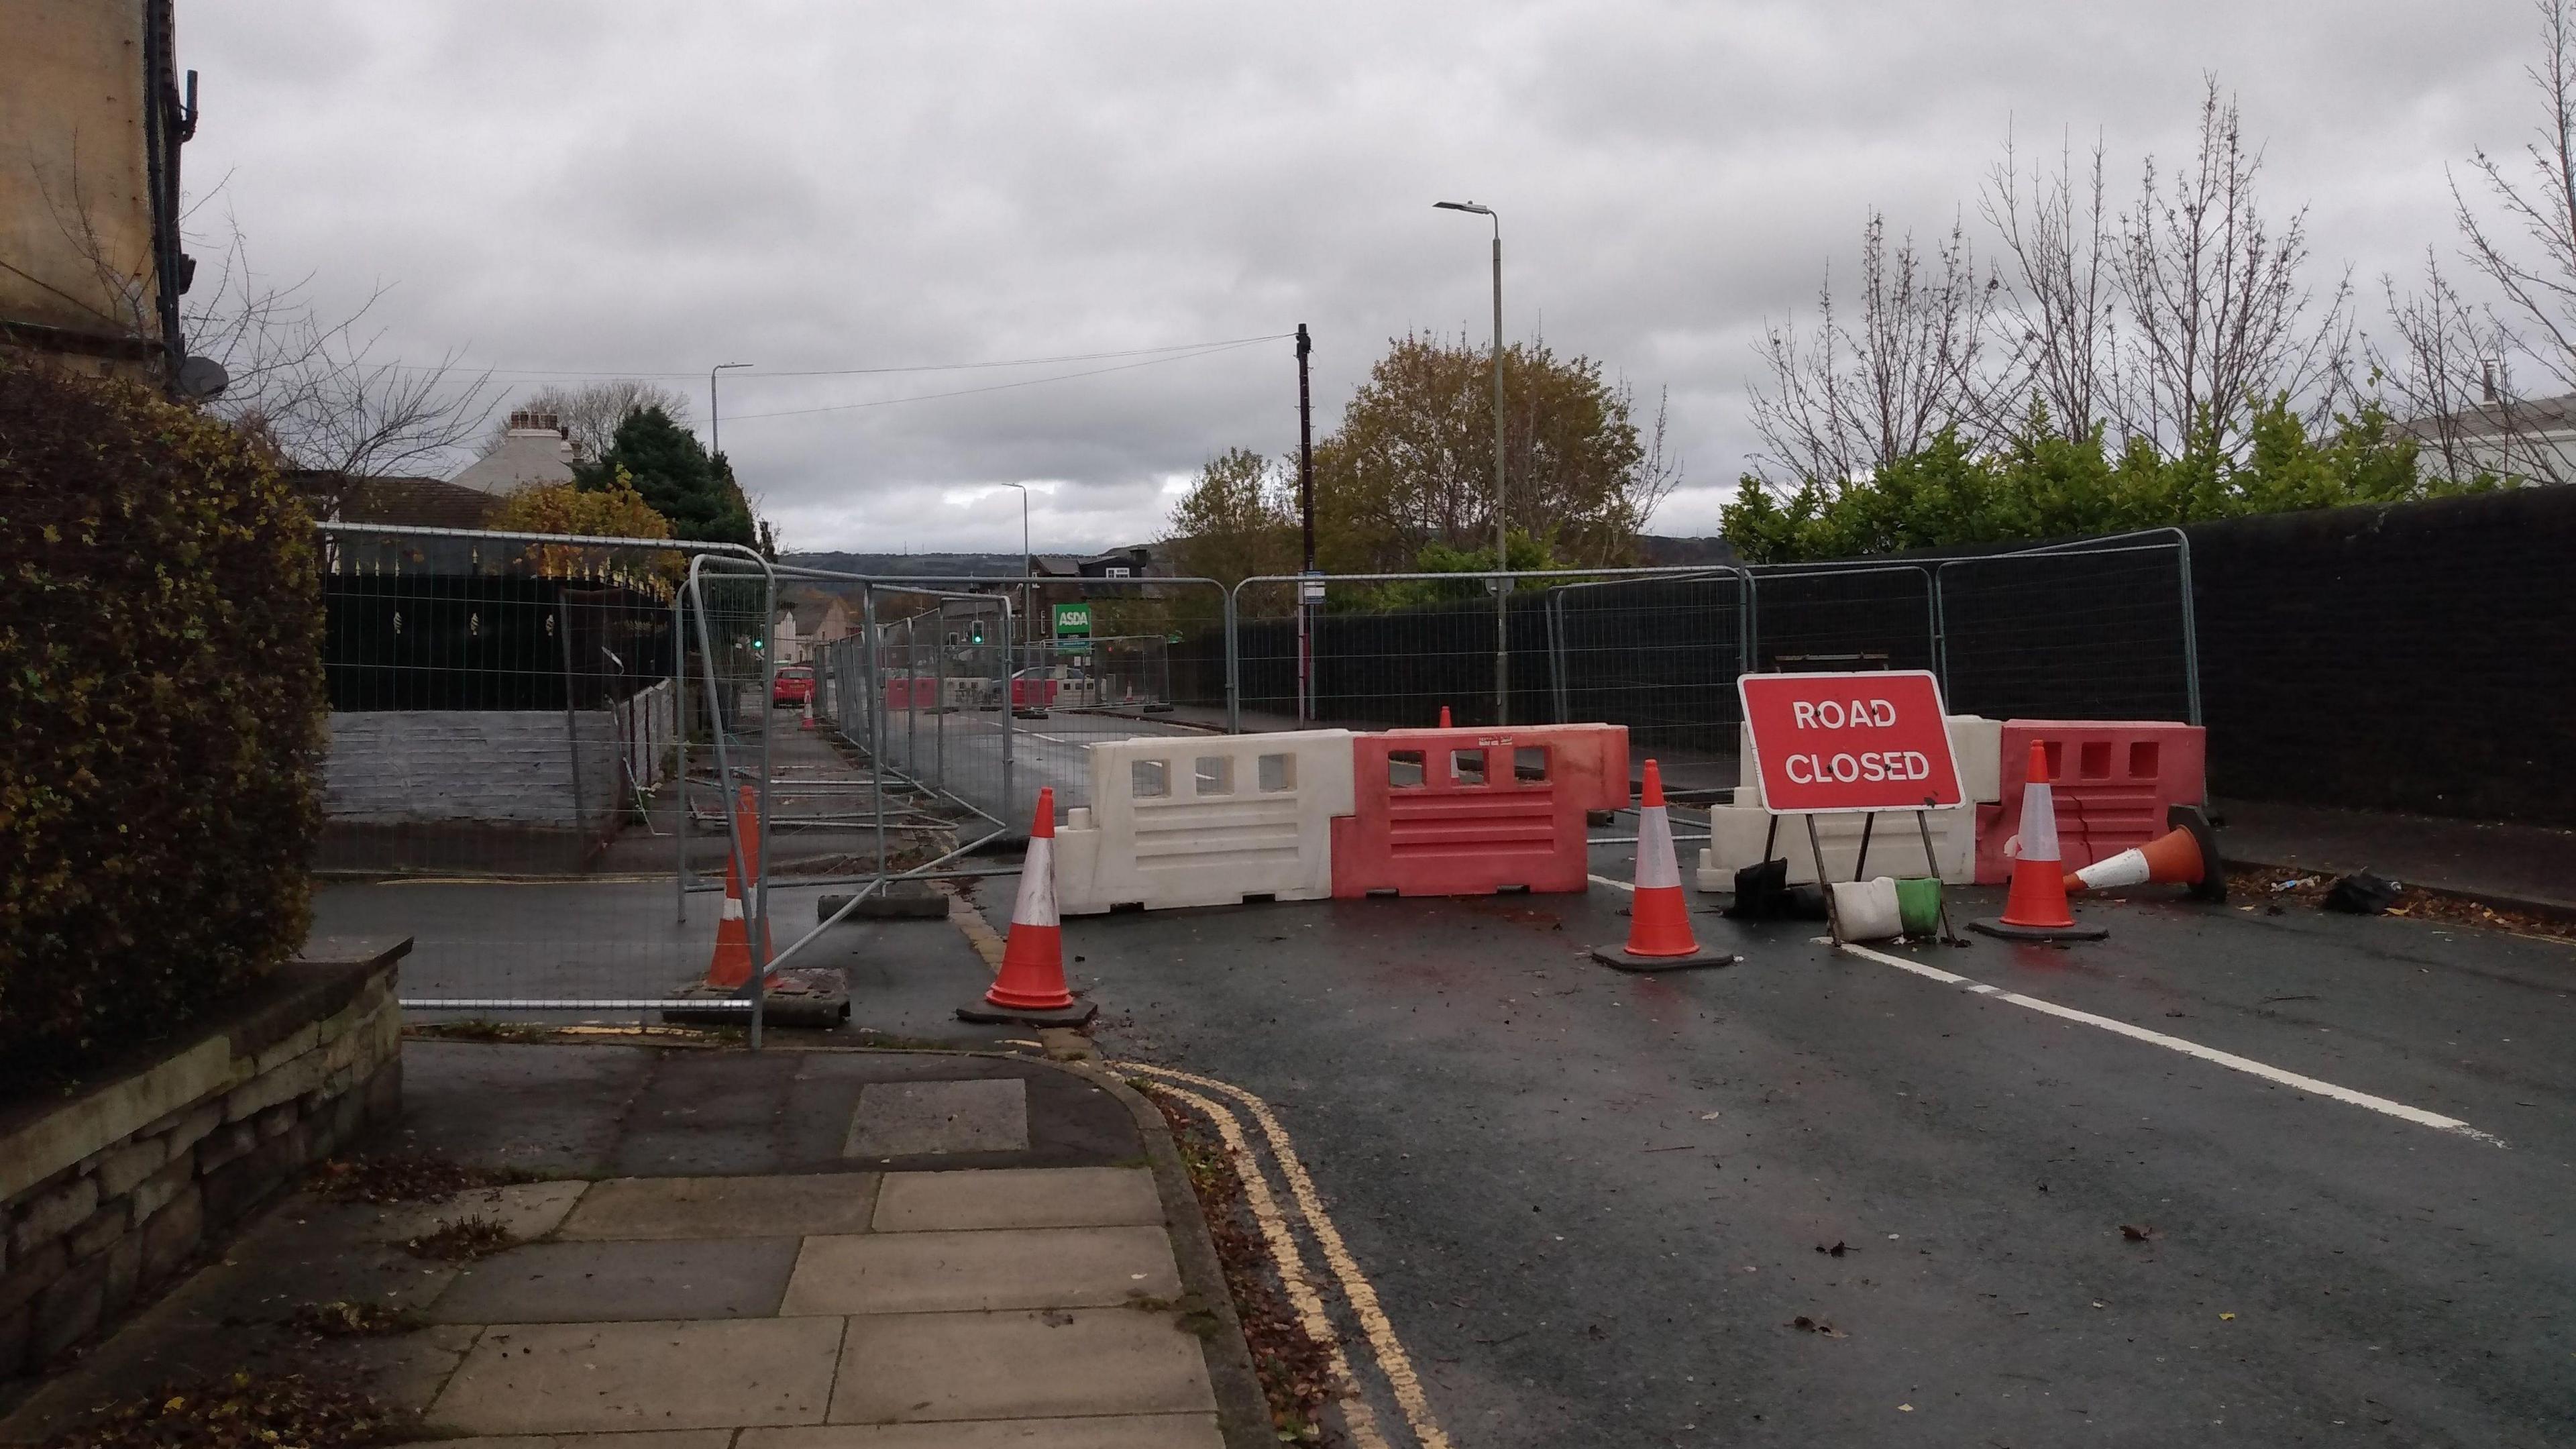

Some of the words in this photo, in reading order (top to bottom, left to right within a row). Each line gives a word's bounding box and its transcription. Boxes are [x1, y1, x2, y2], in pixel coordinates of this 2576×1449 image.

[1059, 612, 1088, 625] ASDA
[1792, 700, 1896, 729] ROAD
[1785, 751, 1929, 784] CLOSED
